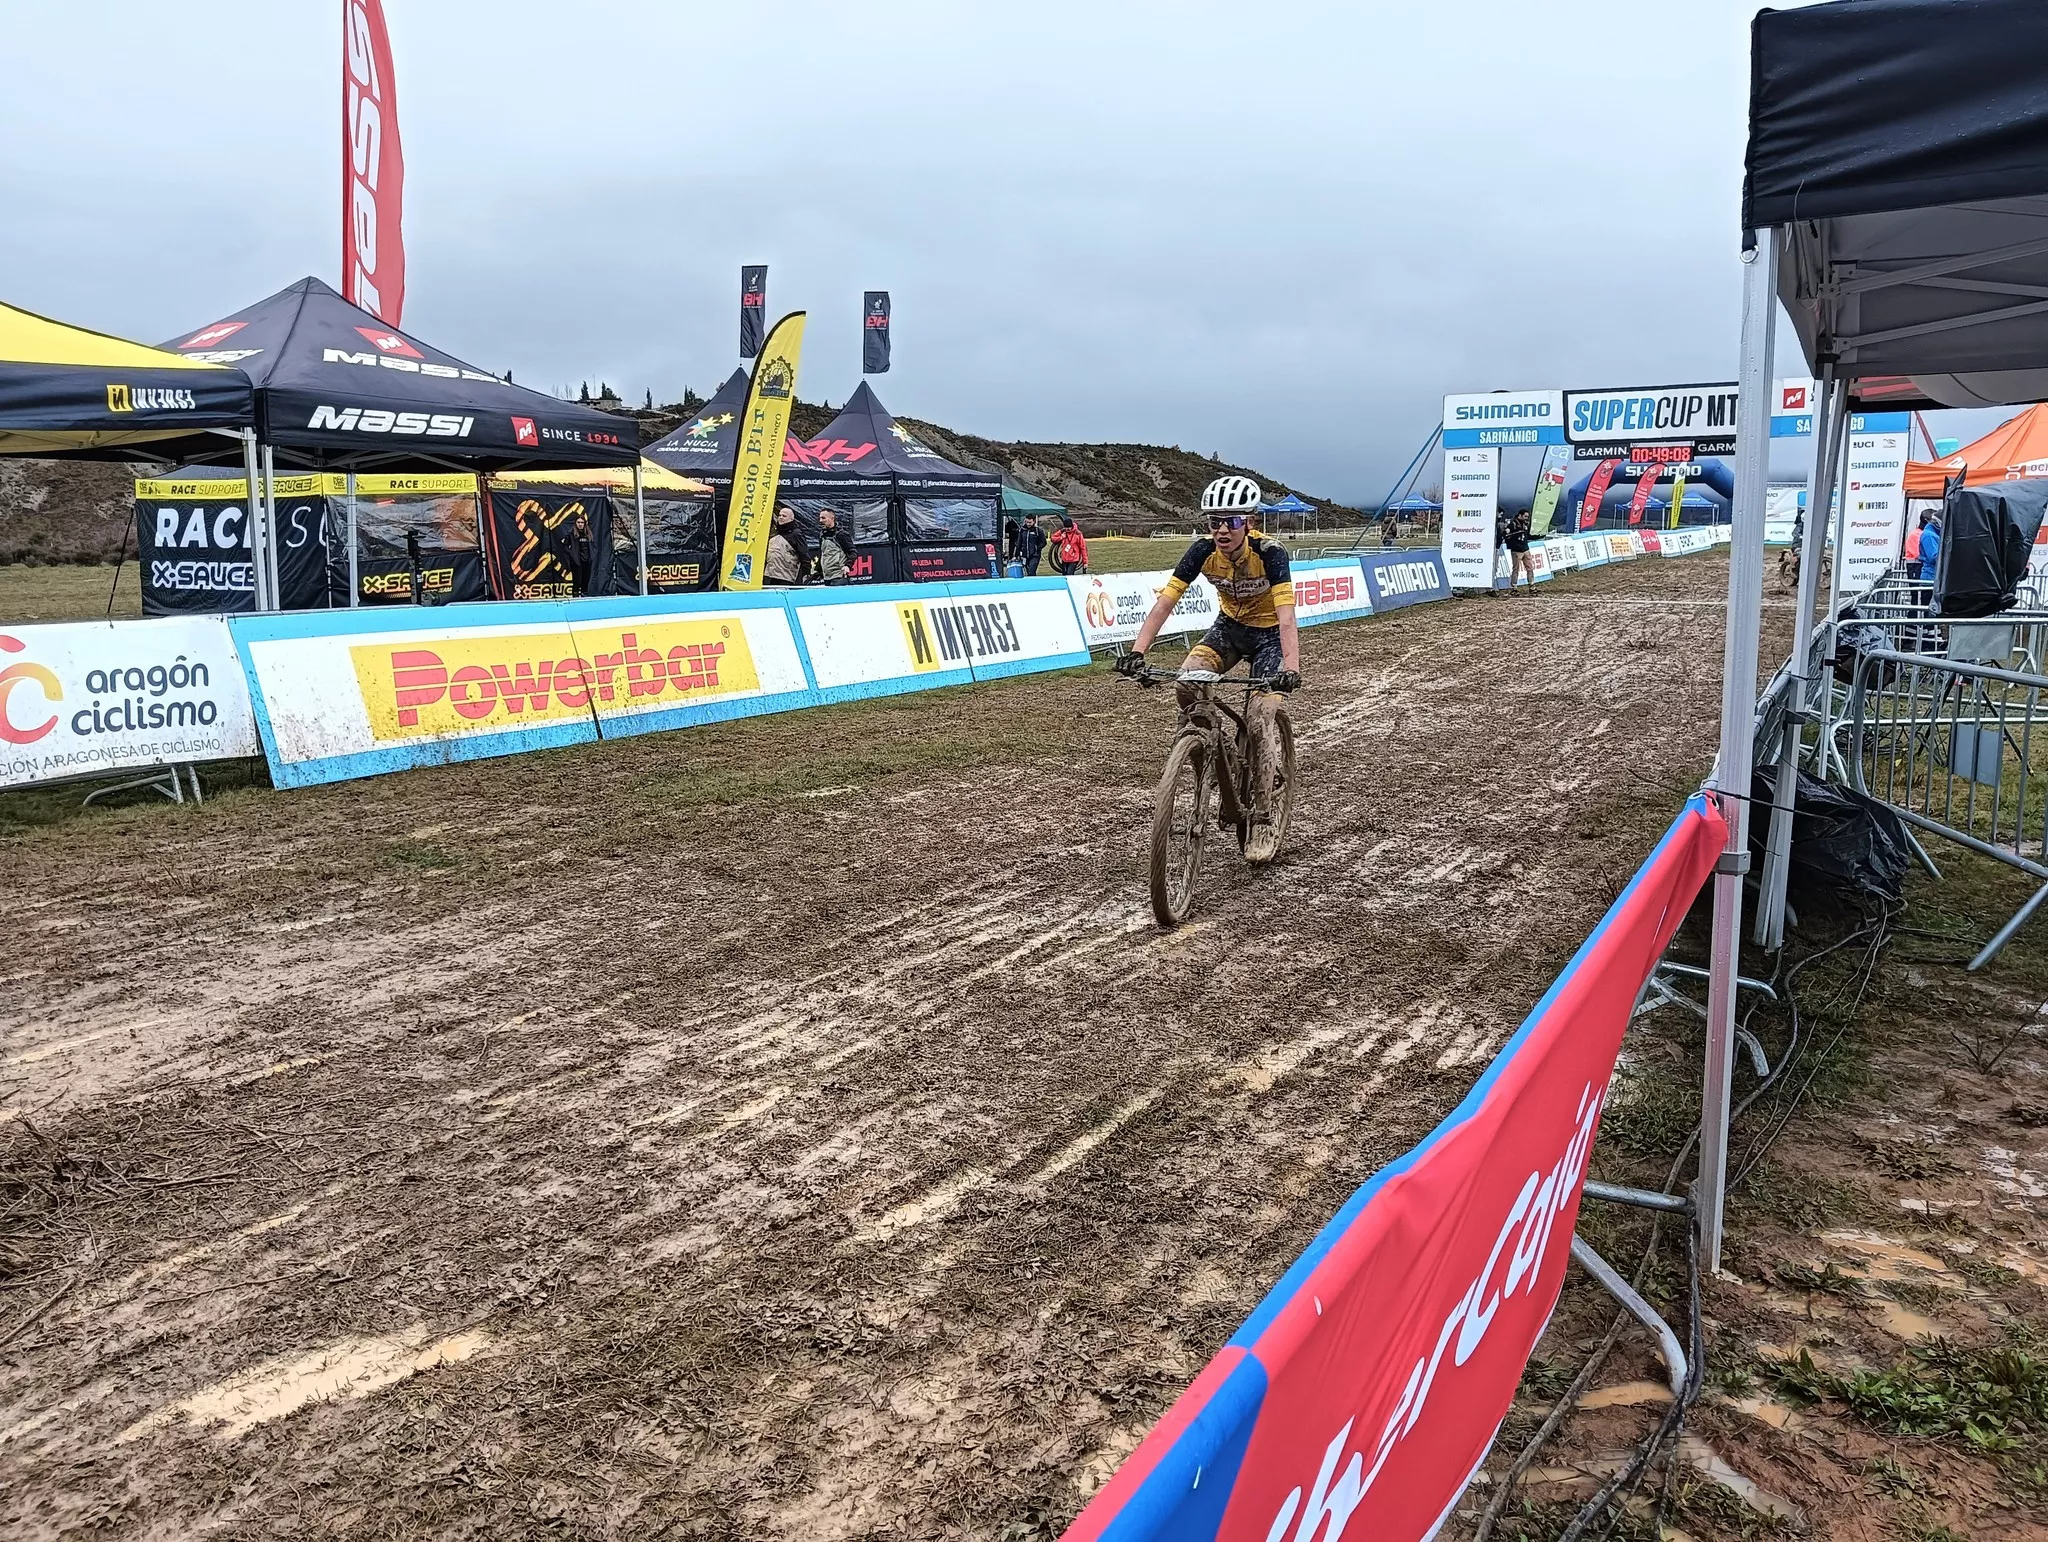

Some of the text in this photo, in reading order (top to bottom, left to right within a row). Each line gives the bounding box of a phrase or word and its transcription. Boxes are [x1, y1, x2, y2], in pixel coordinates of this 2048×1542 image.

[1456, 402, 1551, 420] SHIMANO
[1573, 395, 1703, 432] SUPERCUP
[542, 427, 619, 445] SINCE 1934
[1577, 447, 1626, 457] GARMIN
[1631, 447, 1691, 463] 00:49:08
[1851, 460, 1900, 469] SHIMANO
[389, 479, 469, 488] RACE SUPPORT
[732, 464, 760, 544] Espacio
[746, 408, 765, 457] BTT
[171, 484, 196, 494] RACE
[198, 483, 244, 494] SUPPORT
[1850, 520, 1893, 528] Powerbar
[1848, 557, 1891, 565] SIROKO
[1374, 561, 1440, 598] SHIMANO
[391, 633, 725, 727] Powerbar
[71, 697, 218, 736] ciclismo
[44, 745, 141, 770] ARAGONESA
[162, 738, 221, 754] CICLISMO
